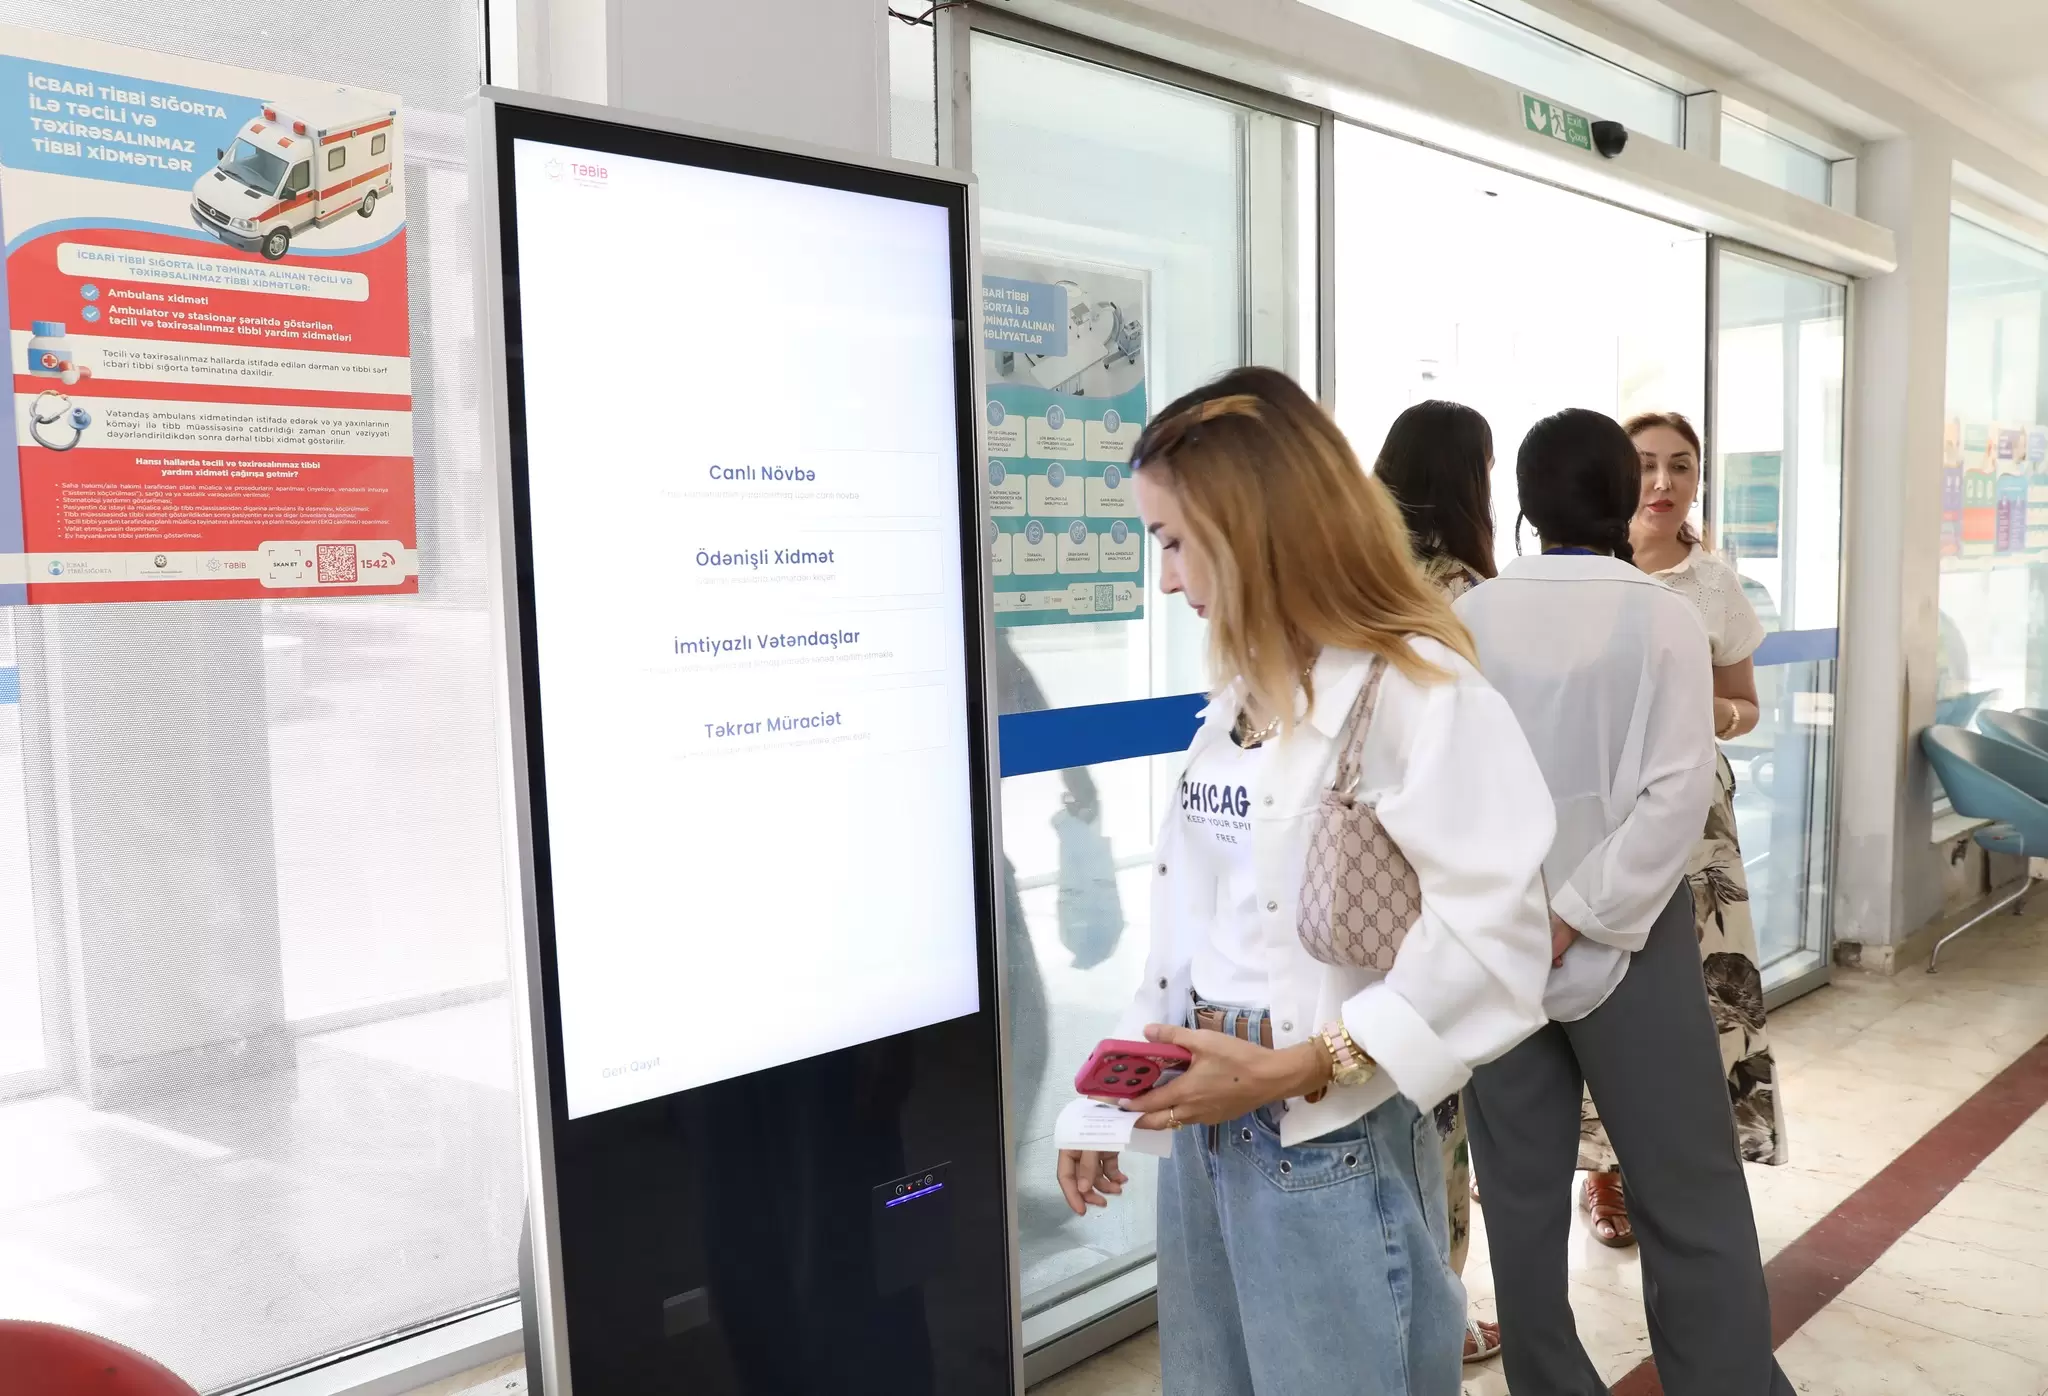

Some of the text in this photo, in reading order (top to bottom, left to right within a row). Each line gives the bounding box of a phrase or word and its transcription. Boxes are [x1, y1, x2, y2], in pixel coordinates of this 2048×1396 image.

[28, 72, 227, 119] İCBARİ TİBBİ SIĞORTA
[29, 94, 156, 127] İLƏ TƏCİLİ VƏ
[1567, 114, 1582, 128] Exit
[30, 117, 195, 153] TƏXİRƏSALINMAZ
[31, 138, 192, 172] TİBBİ XİDMƏTLƏR
[571, 164, 608, 178] TƏBİB
[78, 250, 114, 262] İCBARİ
[118, 255, 145, 264] TİBBİ
[149, 258, 194, 270] SIĞORTA
[197, 261, 212, 271] İLƏ
[216, 265, 266, 277] TƏMİNATA
[269, 271, 306, 280] ALINAN
[308, 274, 338, 284] TƏCİLİ
[129, 267, 222, 284] TƏXİRƏSALINMAZ
[226, 276, 249, 286] TİBBİ
[108, 288, 208, 305] Ambulans xidməti
[982, 288, 1029, 302] BARİ TİBBİ
[109, 305, 168, 318] Ambulator
[188, 310, 236, 323] stasionar
[239, 316, 280, 326] şəraitdə
[284, 319, 333, 330] göstərilən
[1015, 304, 1029, 315] İLƏ
[109, 316, 137, 326] təcili
[157, 320, 234, 333] təxirəsalınmaz
[238, 326, 261, 336] tibbi
[265, 330, 299, 338] yardım
[302, 332, 352, 342] xidmətləri
[984, 314, 1054, 332] MİNATA ALINAN
[103, 350, 126, 358] Təcili
[143, 352, 208, 363] təxirəsalınmaz
[210, 356, 245, 365] hallarda
[248, 359, 278, 367] istifadə
[157, 364, 188, 372] sığorta
[192, 366, 238, 374] təminatına
[106, 410, 149, 419] Vətəndaş
[199, 414, 254, 422] xidmətindən
[106, 420, 140, 429] köməyi
[187, 423, 243, 432] müəssisəsinə
[249, 426, 294, 435] çatdırıldığı
[107, 430, 195, 440] dəyərləndirildikdən
[308, 436, 345, 445] göstərilir.
[709, 465, 816, 481] Canlı Növbə
[361, 560, 388, 569] 1542
[696, 548, 834, 570] Ödənişli Xidmət
[674, 629, 860, 657] İmtiyazlı Vətəndaşlar
[704, 712, 842, 739] Təkrar Müraciət
[1181, 781, 1251, 817] CHICAG
[1187, 814, 1206, 823] KEEP
[1208, 818, 1230, 828] YOUR
[1216, 834, 1237, 844] FREE
